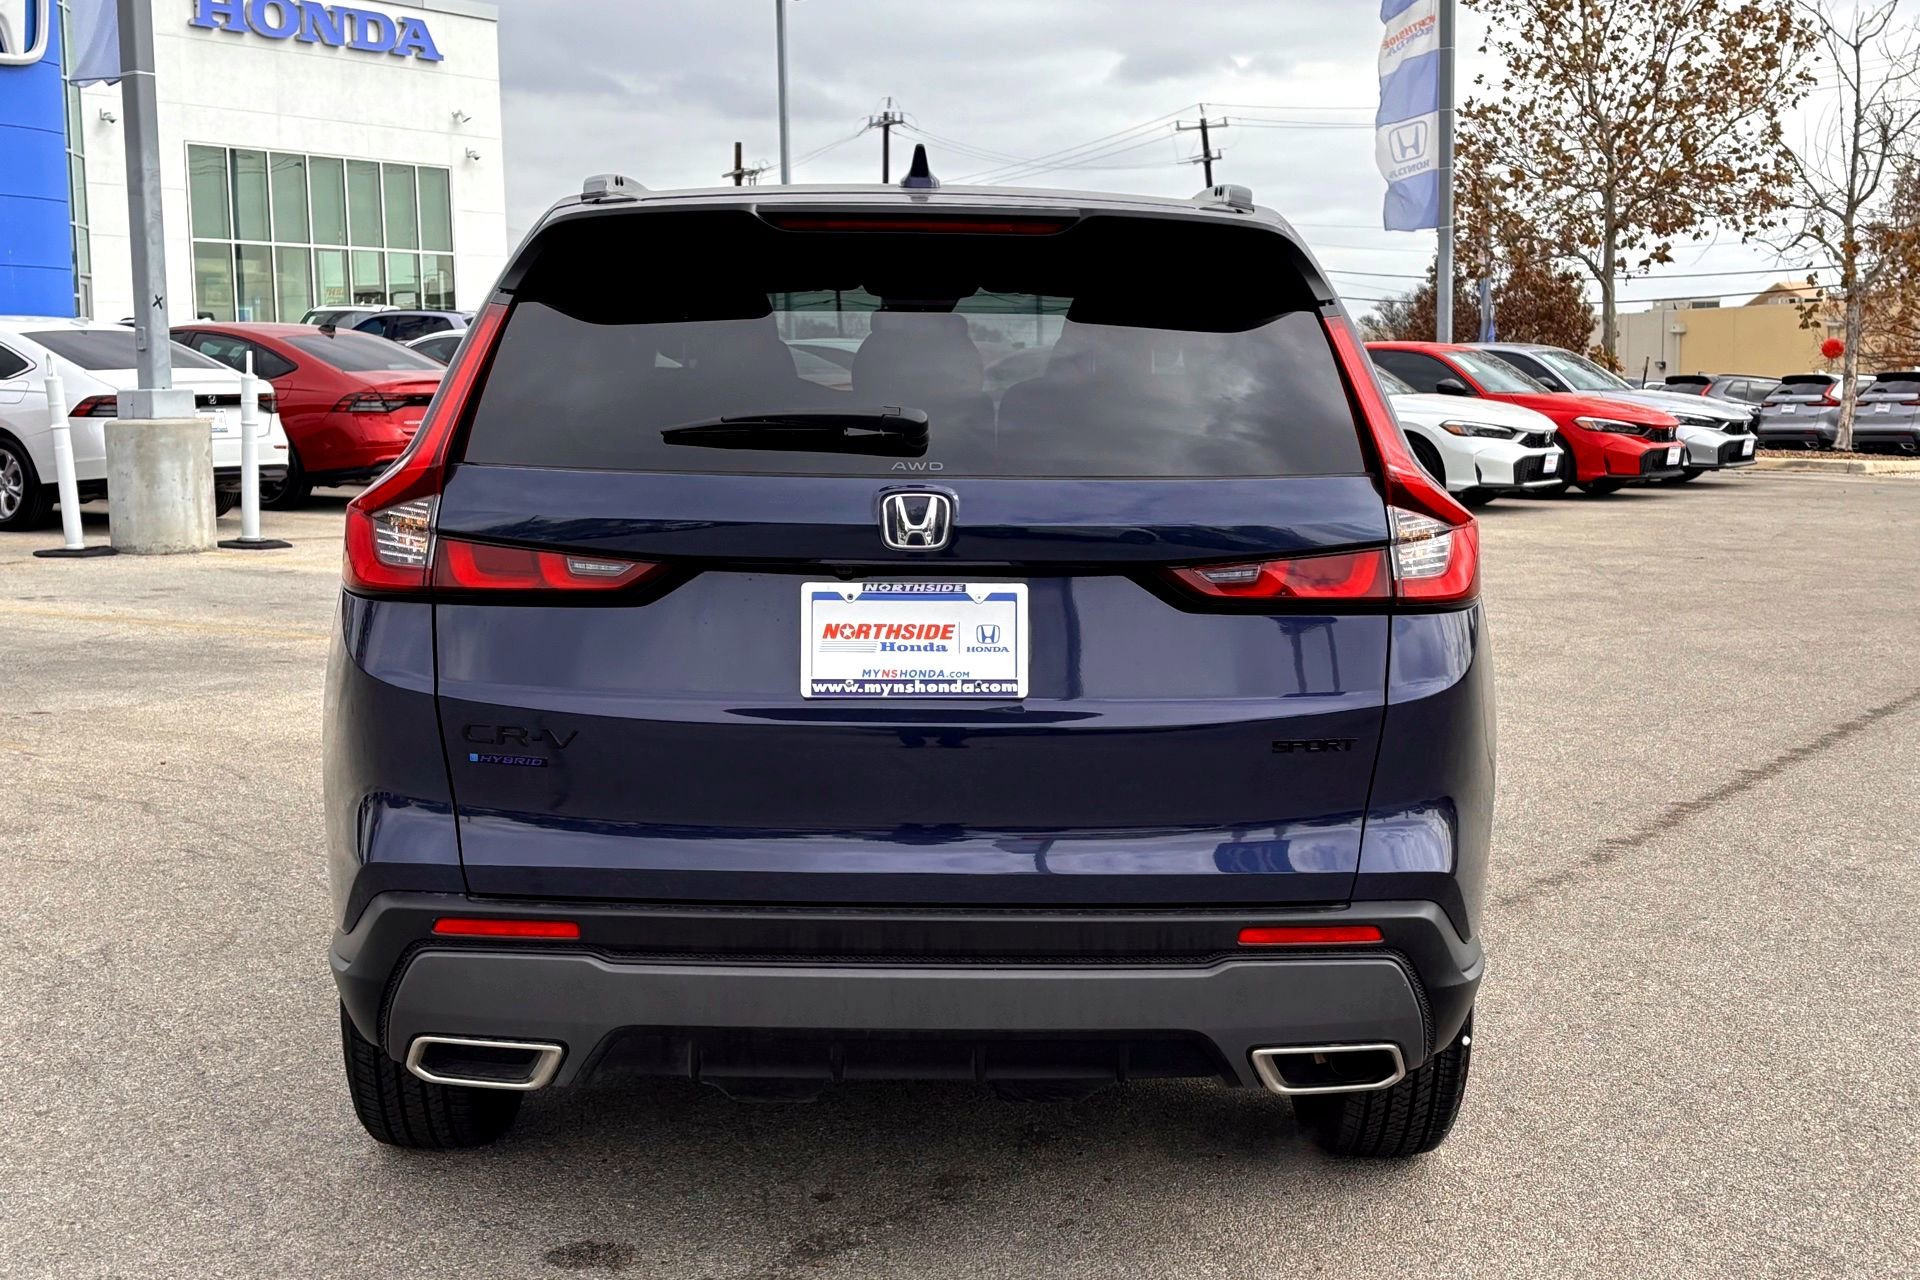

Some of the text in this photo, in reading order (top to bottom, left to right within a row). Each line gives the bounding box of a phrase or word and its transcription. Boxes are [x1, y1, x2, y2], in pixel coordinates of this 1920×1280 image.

[187, 0, 444, 61] HONDA
[891, 462, 943, 470] AWD
[865, 583, 964, 592] NORTHSIDE
[823, 623, 956, 640] NORTHSIDE
[880, 642, 948, 652] Honda
[812, 681, 1018, 696] www.mynshonda.com
[463, 723, 579, 748] CR-V
[1271, 738, 1358, 753] SPORT
[479, 755, 543, 766] HYBRID
